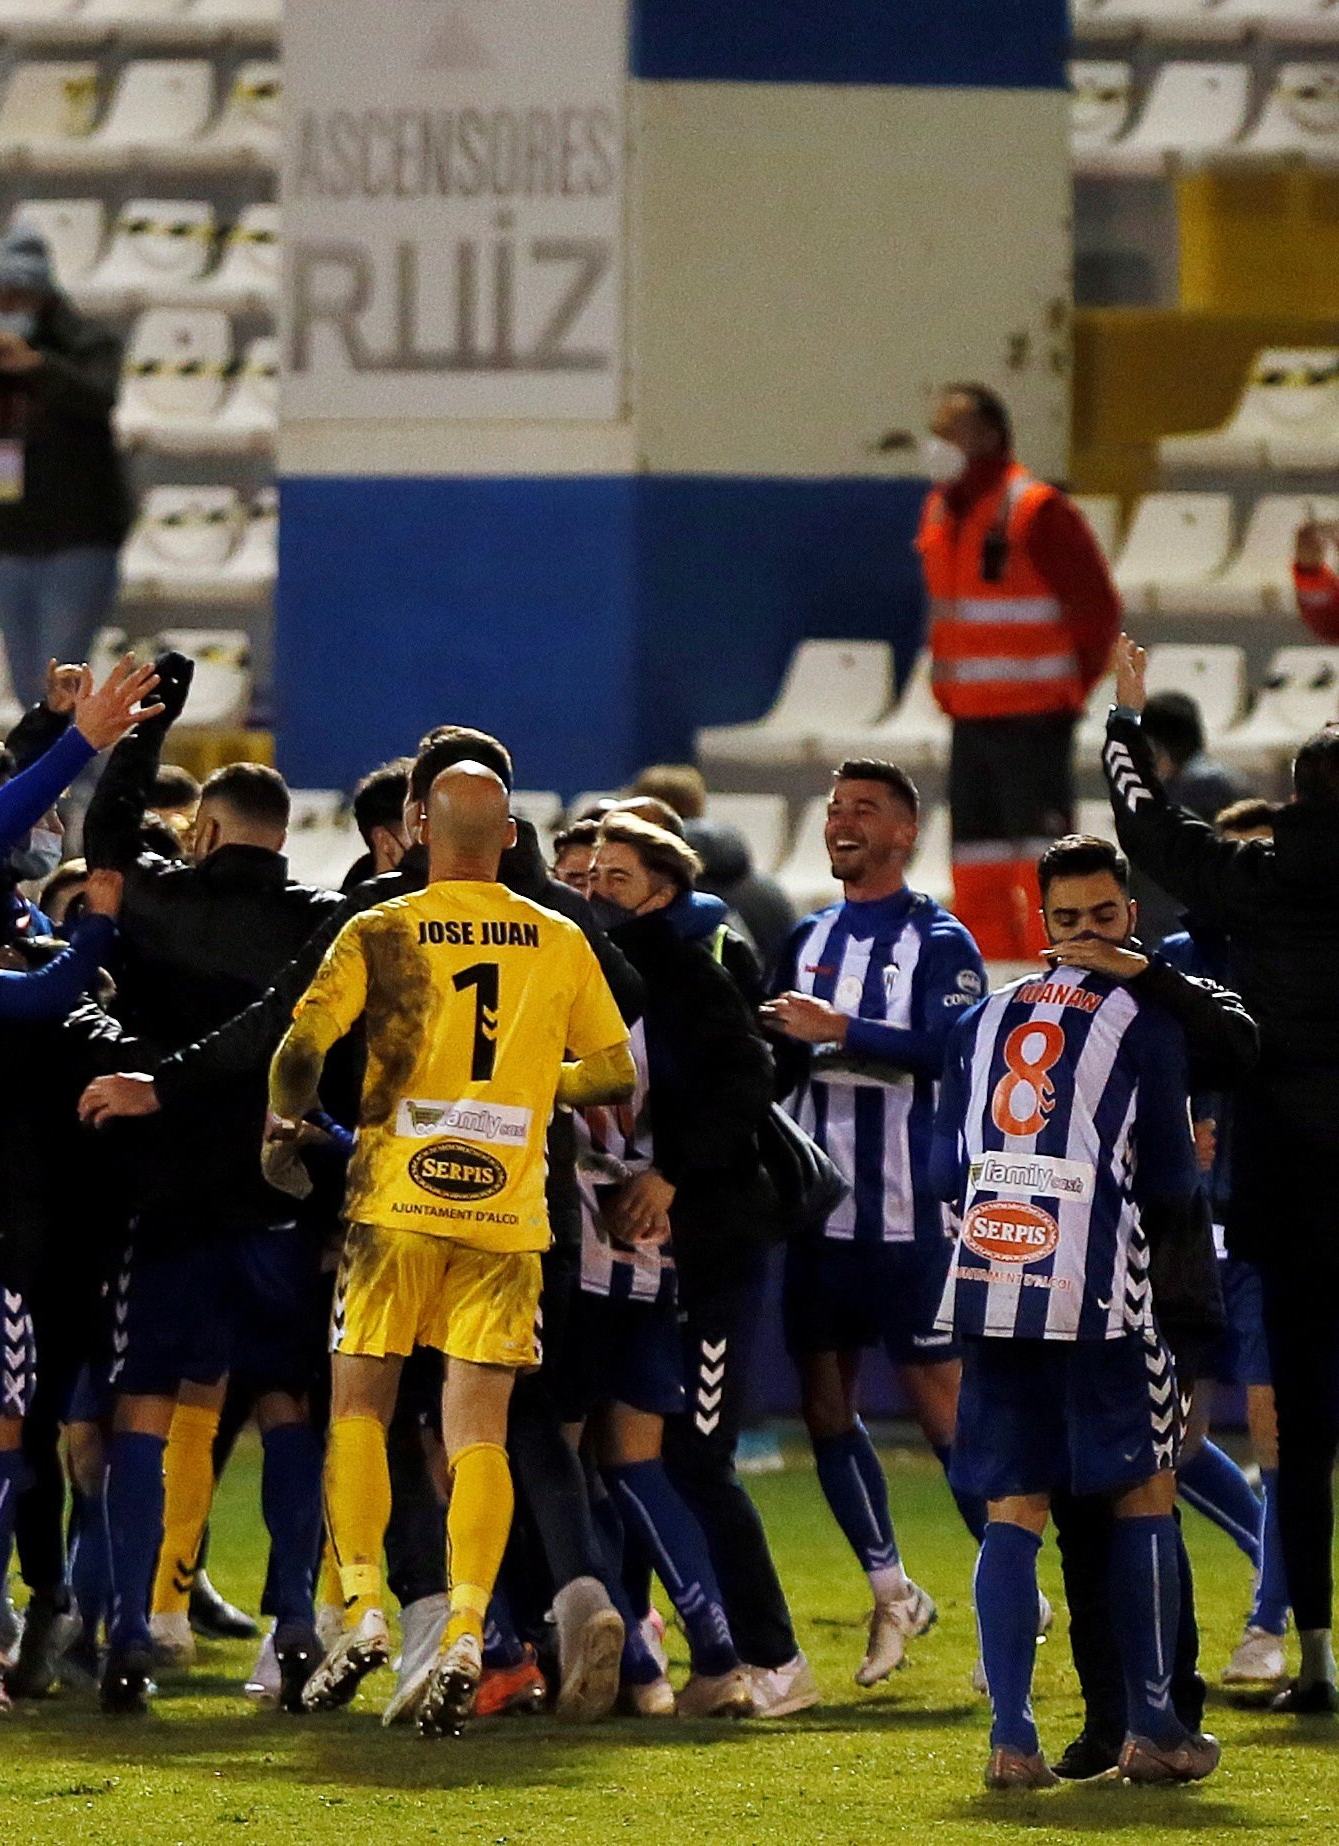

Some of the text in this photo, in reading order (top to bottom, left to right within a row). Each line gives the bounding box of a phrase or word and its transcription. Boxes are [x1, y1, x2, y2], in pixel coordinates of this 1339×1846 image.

[295, 106, 612, 198] ASCENSORES
[417, 920, 540, 948] JOSE JUAN
[451, 961, 500, 1082] 1
[991, 1019, 1066, 1138] 8
[446, 1109, 503, 1139] amily
[421, 1157, 495, 1184] SERPIS
[984, 1158, 1053, 1192] family
[391, 1202, 473, 1222] AJUNTAMENT
[973, 1216, 1047, 1246] SERPIS
